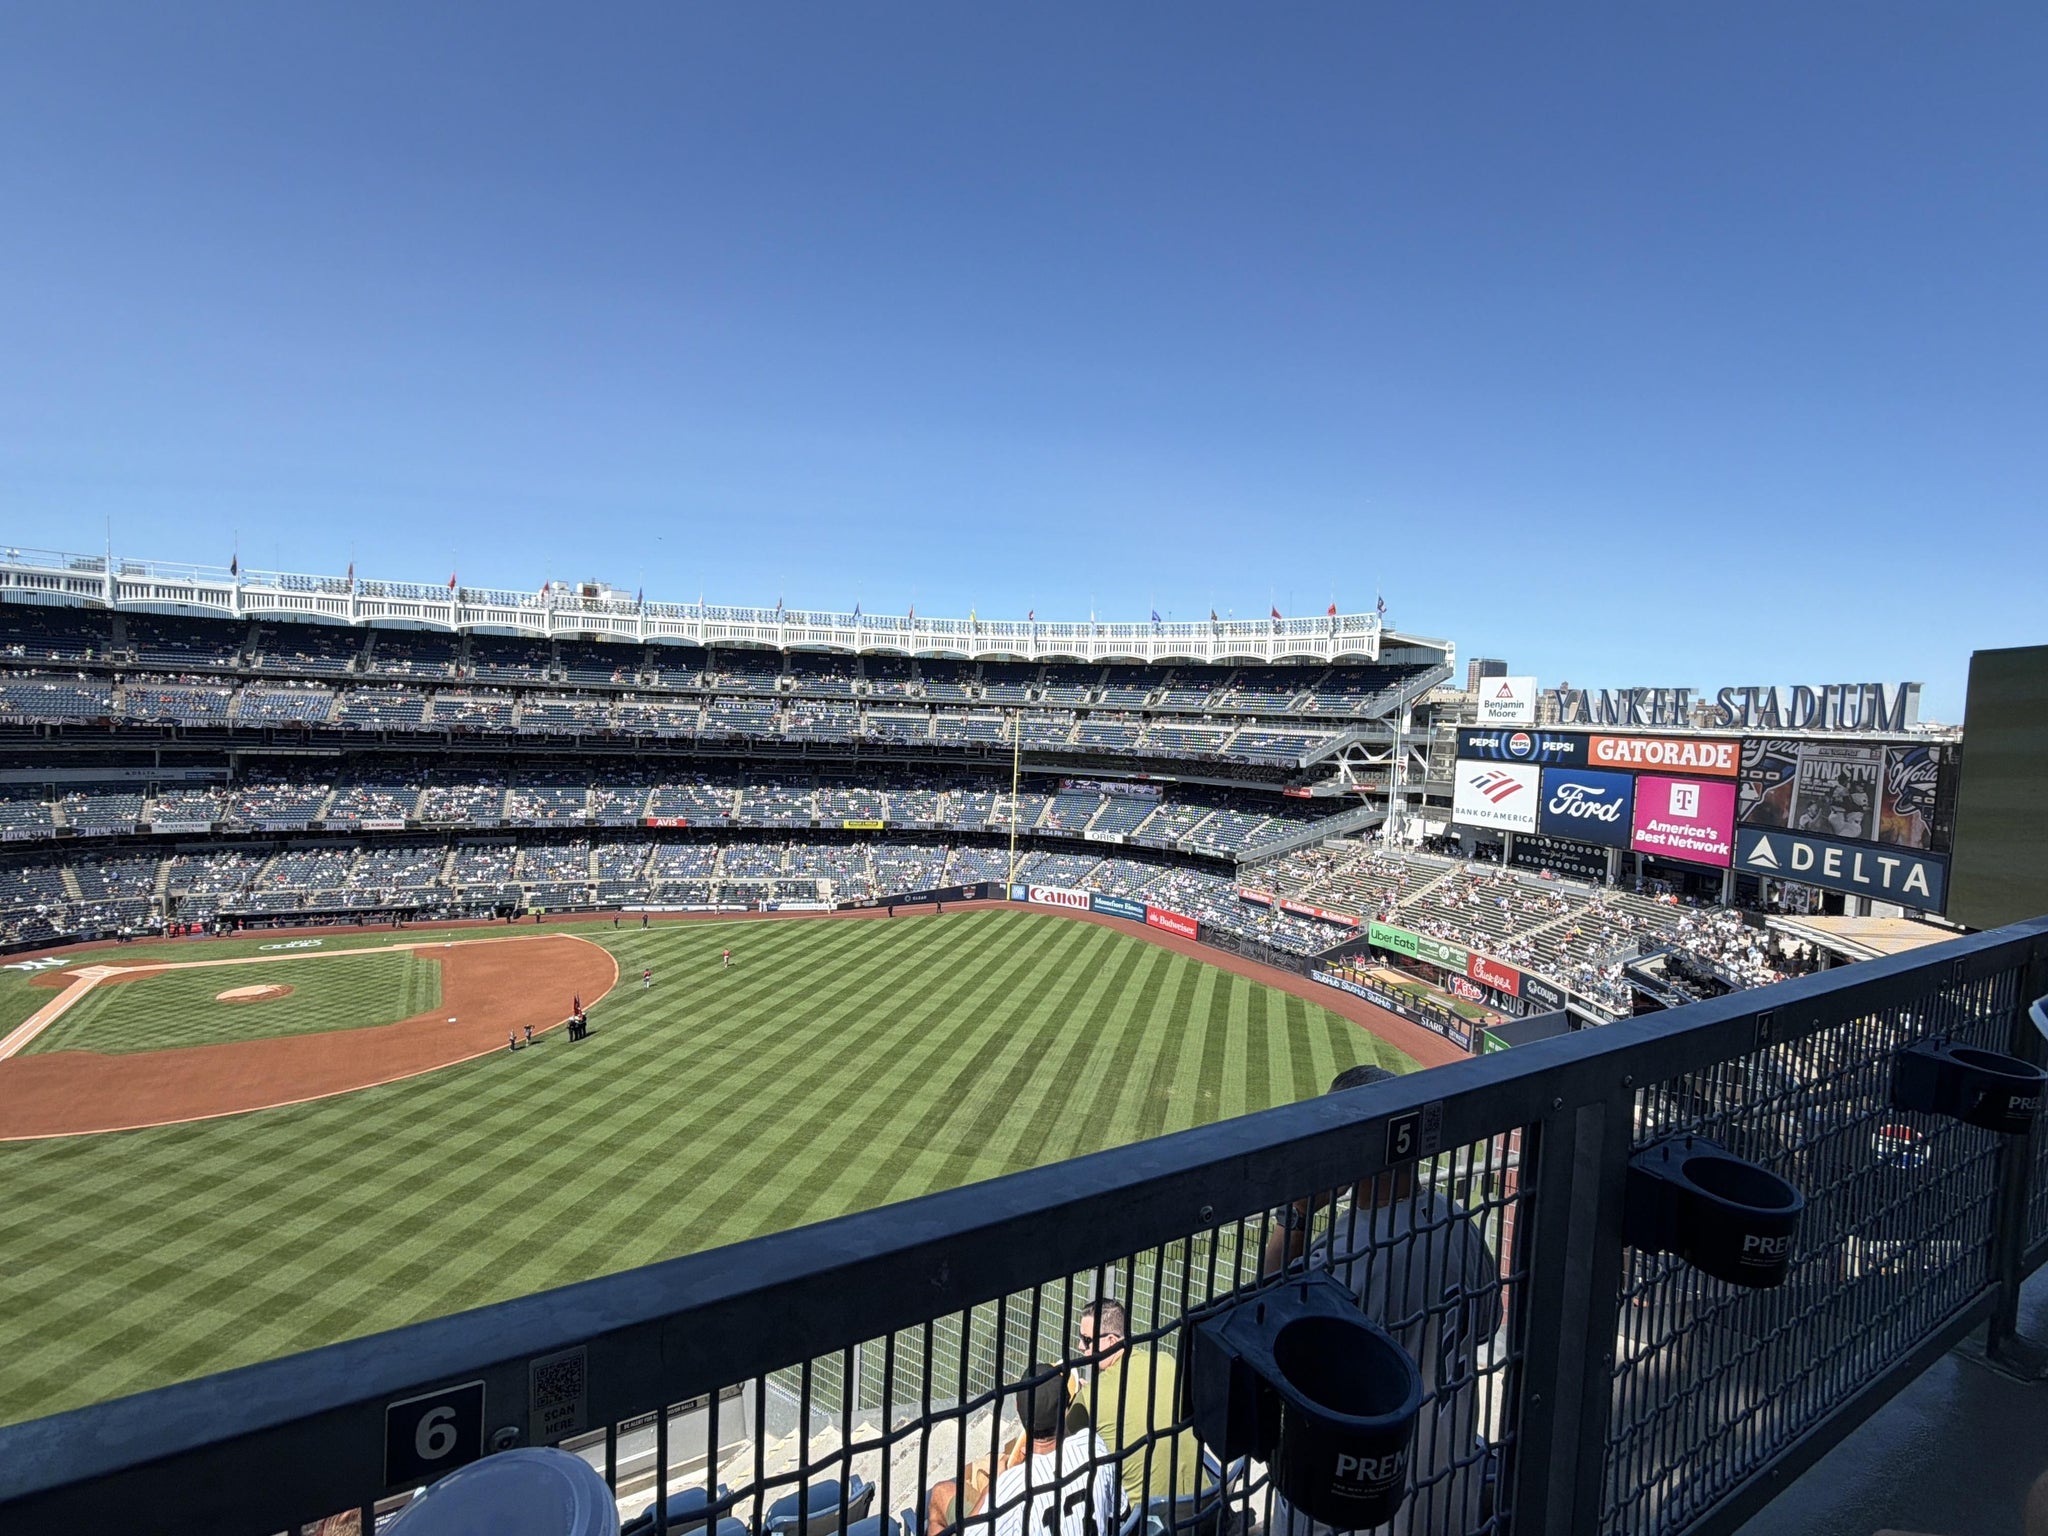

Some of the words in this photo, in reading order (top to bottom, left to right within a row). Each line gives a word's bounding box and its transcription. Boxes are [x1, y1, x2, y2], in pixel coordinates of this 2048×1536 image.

[1484, 700, 1525, 710] Benjamin
[1488, 709, 1517, 718] Moore
[1553, 687, 1695, 727] YANKEE
[1715, 682, 1916, 731] STADIUM
[1469, 738, 1499, 747] PEPSI
[1542, 741, 1575, 752] PEPSI
[1597, 739, 1733, 769] GATORADE
[1802, 760, 1878, 785] DYNASTY!
[1549, 783, 1624, 822] Ford
[656, 818, 678, 826] AVIS
[1455, 807, 1478, 817] BANK
[1481, 810, 1491, 818] OF
[1493, 812, 1534, 824] AMERICA
[89, 826, 131, 835] DYNASTY!
[1092, 832, 1116, 842] ORIS
[1647, 820, 1718, 840] America's
[1636, 830, 1667, 845] Best
[1667, 836, 1730, 856] Network
[1791, 842, 1930, 897] DELTA
[1030, 887, 1088, 908] Canon
[1160, 915, 1195, 935] Budweiser
[1370, 928, 1393, 943] Uber
[1393, 935, 1416, 951] Eats
[1313, 972, 1340, 987] StubHub
[1341, 981, 1366, 998] StubHub
[1367, 992, 1392, 1009] StubHub
[1537, 985, 1558, 1004] coupa
[1490, 990, 1499, 1007] A
[1501, 993, 1525, 1017] SUB
[1420, 1016, 1444, 1035] STARR
[1761, 1018, 1769, 1039] 4
[1396, 1122, 1411, 1154] 5
[544, 1404, 576, 1422] SCAN
[415, 1406, 457, 1460] 6
[545, 1418, 576, 1435] HERE
